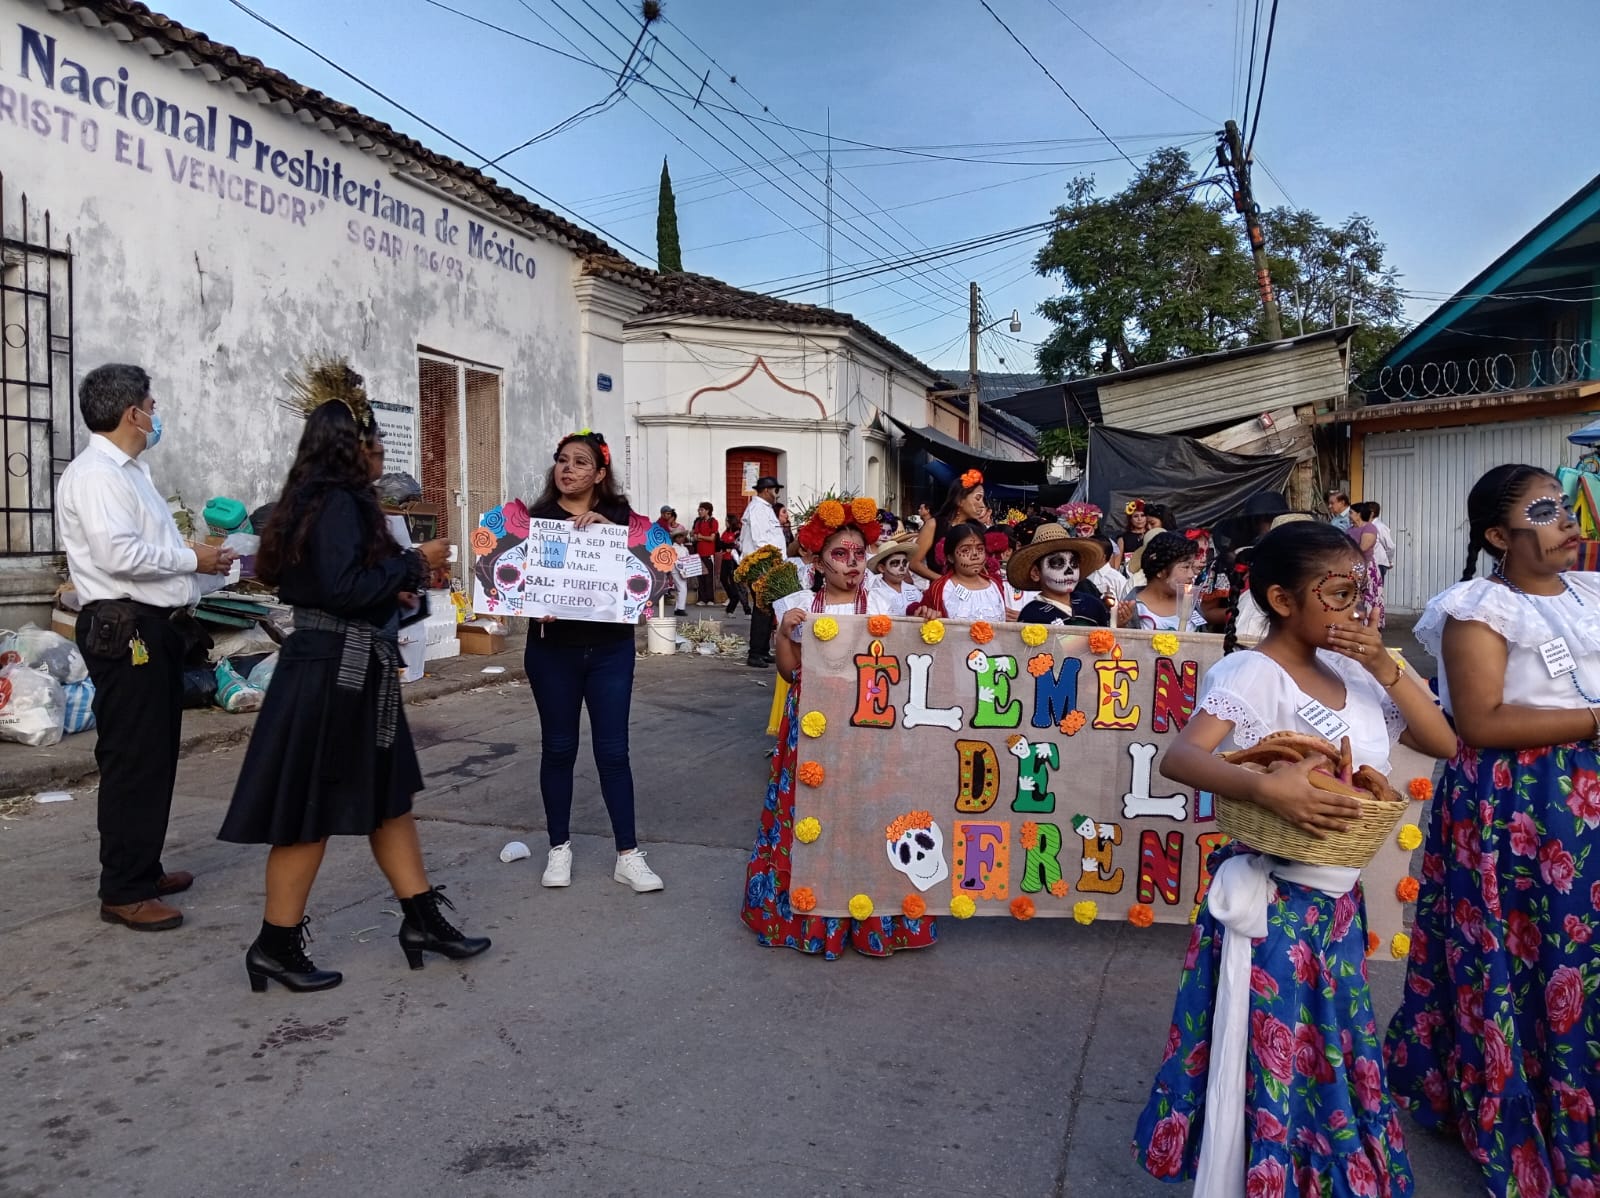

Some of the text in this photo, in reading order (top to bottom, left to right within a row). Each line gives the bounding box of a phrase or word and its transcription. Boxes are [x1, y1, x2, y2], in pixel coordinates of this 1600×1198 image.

[16, 23, 536, 279] Nacional Presbiteriana de México
[115, 129, 152, 173] EL
[533, 520, 566, 531] AGUA:
[600, 527, 628, 537] AGUA
[531, 533, 627, 550] SACIA LA SED DEL
[531, 546, 627, 562] ALMA TRAS EL
[530, 559, 598, 572] LARGO VIAJE.
[526, 575, 619, 592] SAL: PURIFICA
[525, 592, 596, 607] EL CUERPO.
[954, 738, 1060, 814] DE
